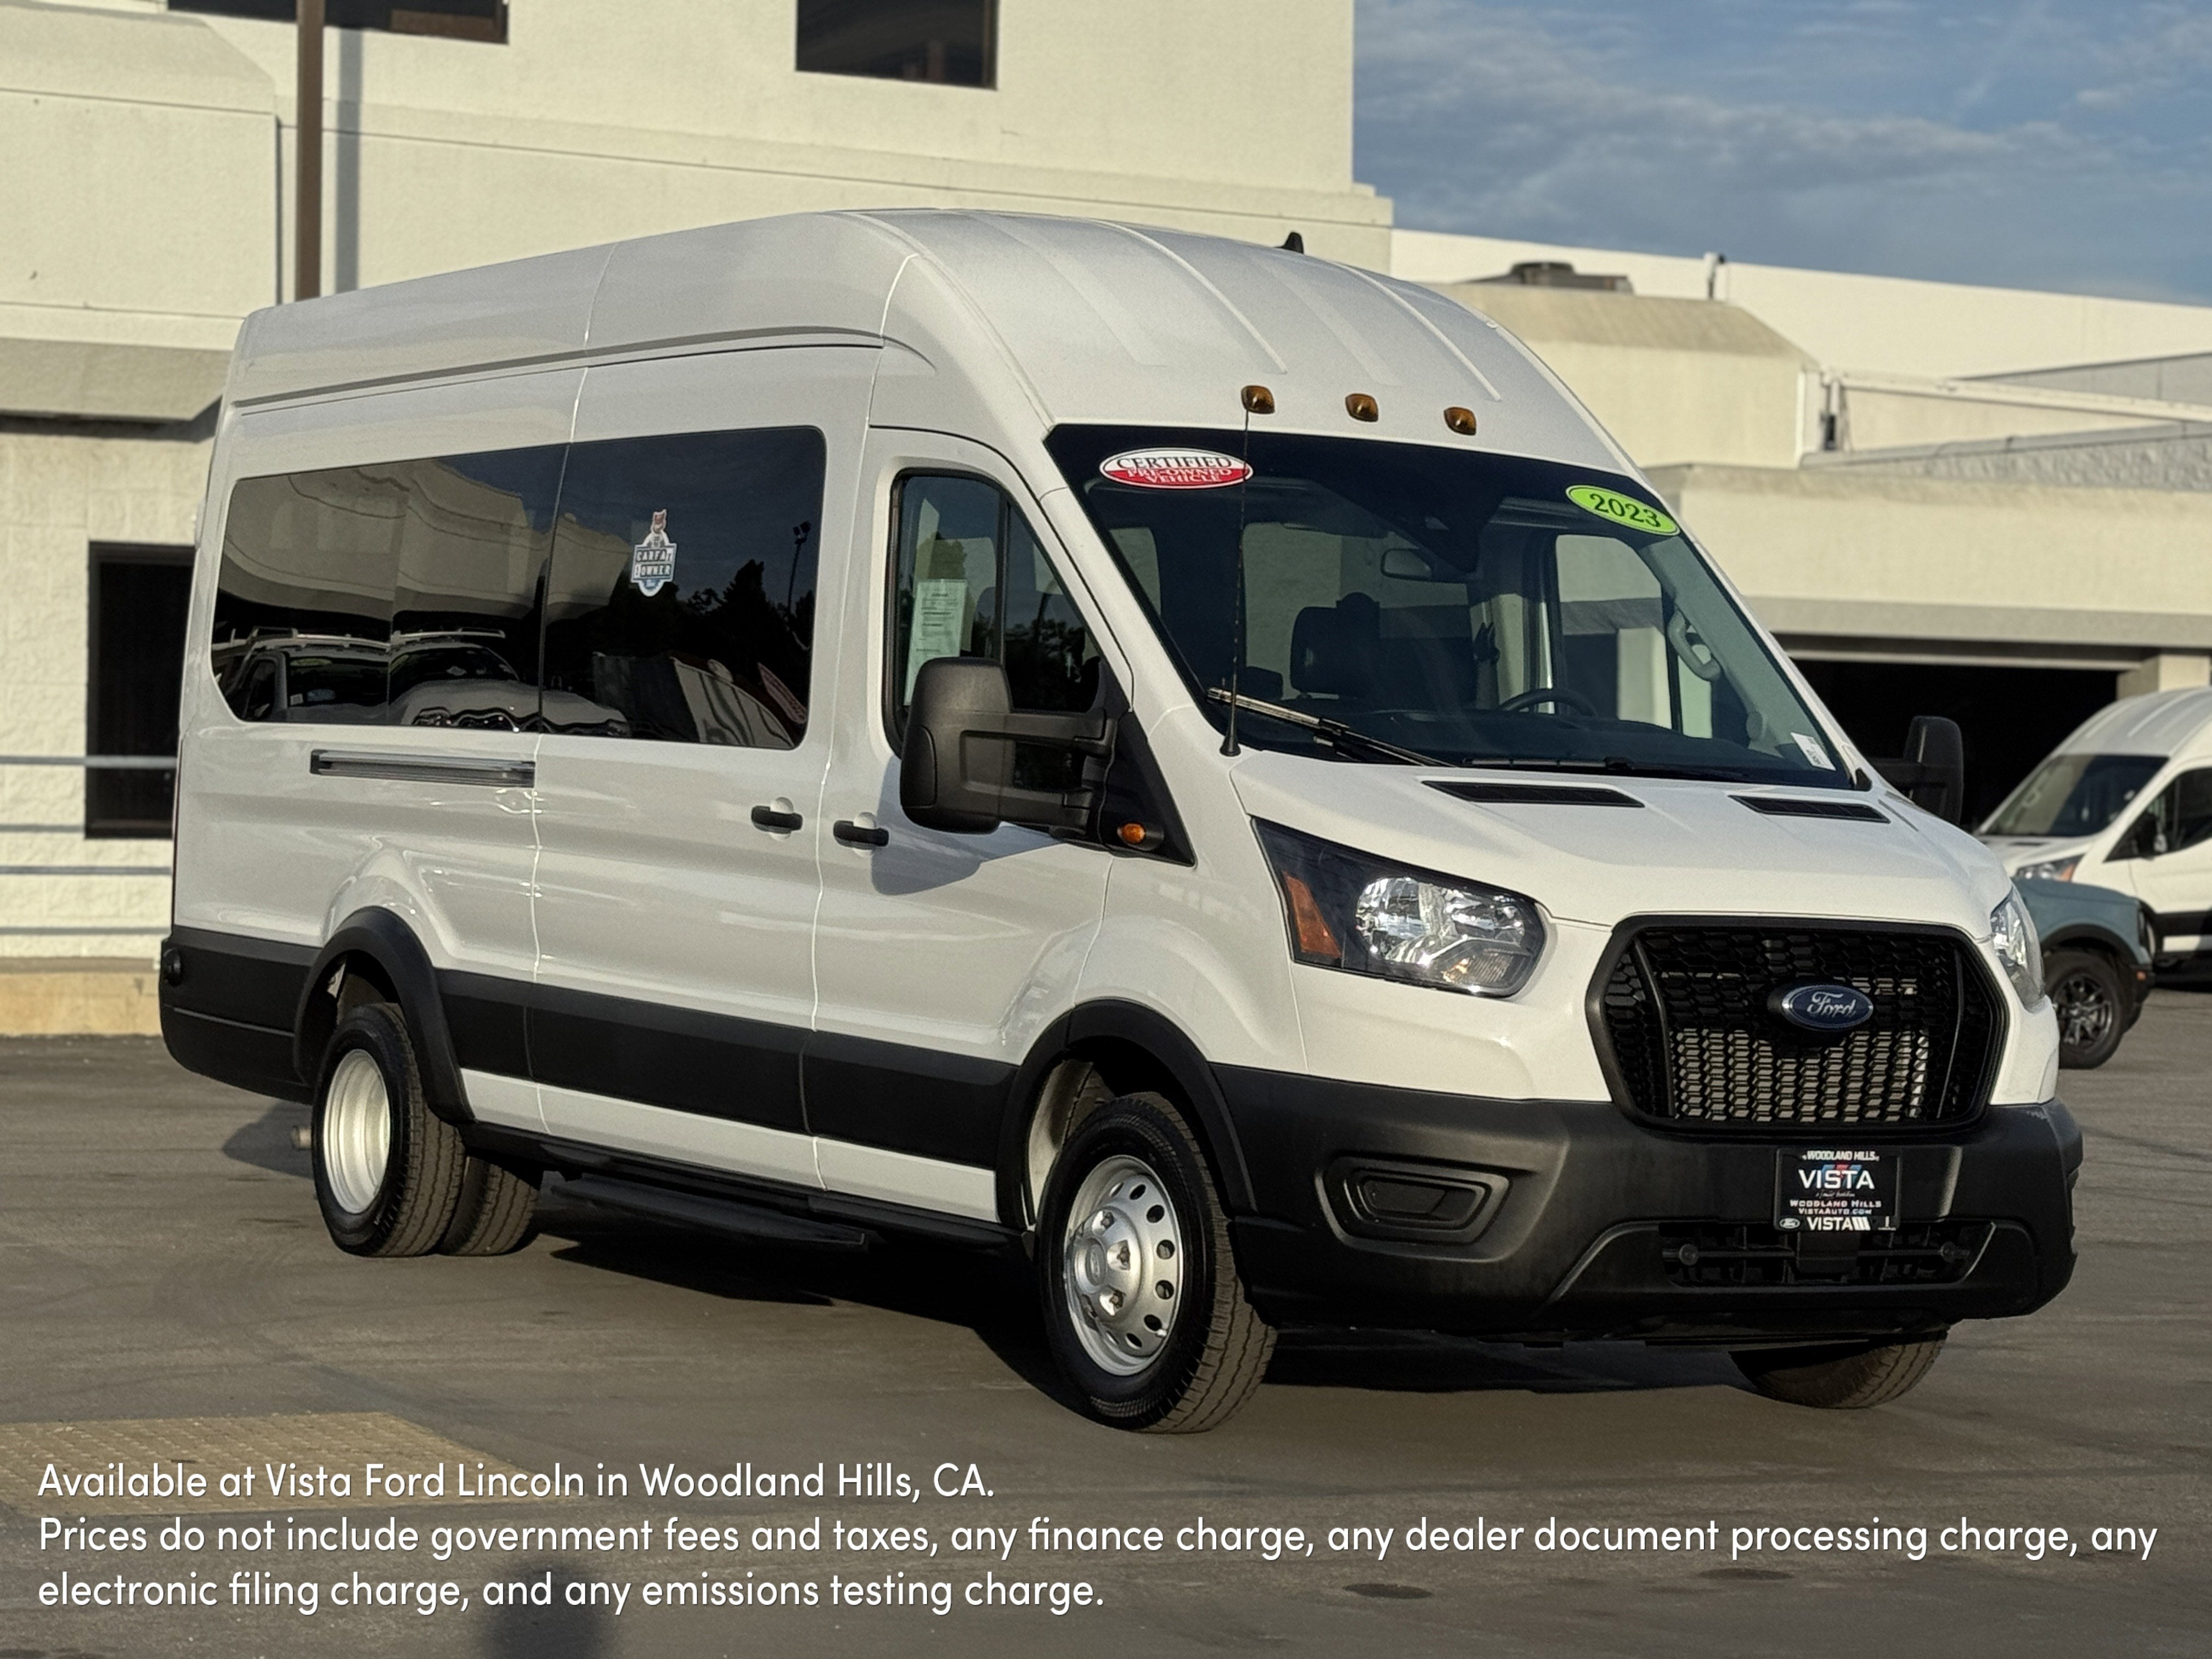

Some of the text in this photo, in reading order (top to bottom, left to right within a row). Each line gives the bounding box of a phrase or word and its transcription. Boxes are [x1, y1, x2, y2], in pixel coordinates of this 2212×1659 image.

[1116, 456, 1232, 470] CERTIFIED
[1127, 468, 1232, 478] PRE-OWNED
[1146, 473, 1222, 483] VEHICLE
[1589, 493, 1661, 528] 2023
[1807, 991, 1857, 1018] Ford
[1806, 1150, 1876, 1161] WOODLAND HILLS
[1798, 1169, 1875, 1189] VISTA
[1790, 1199, 1882, 1208] WOODLAND HILLS
[1806, 1216, 1854, 1231] VISTA
